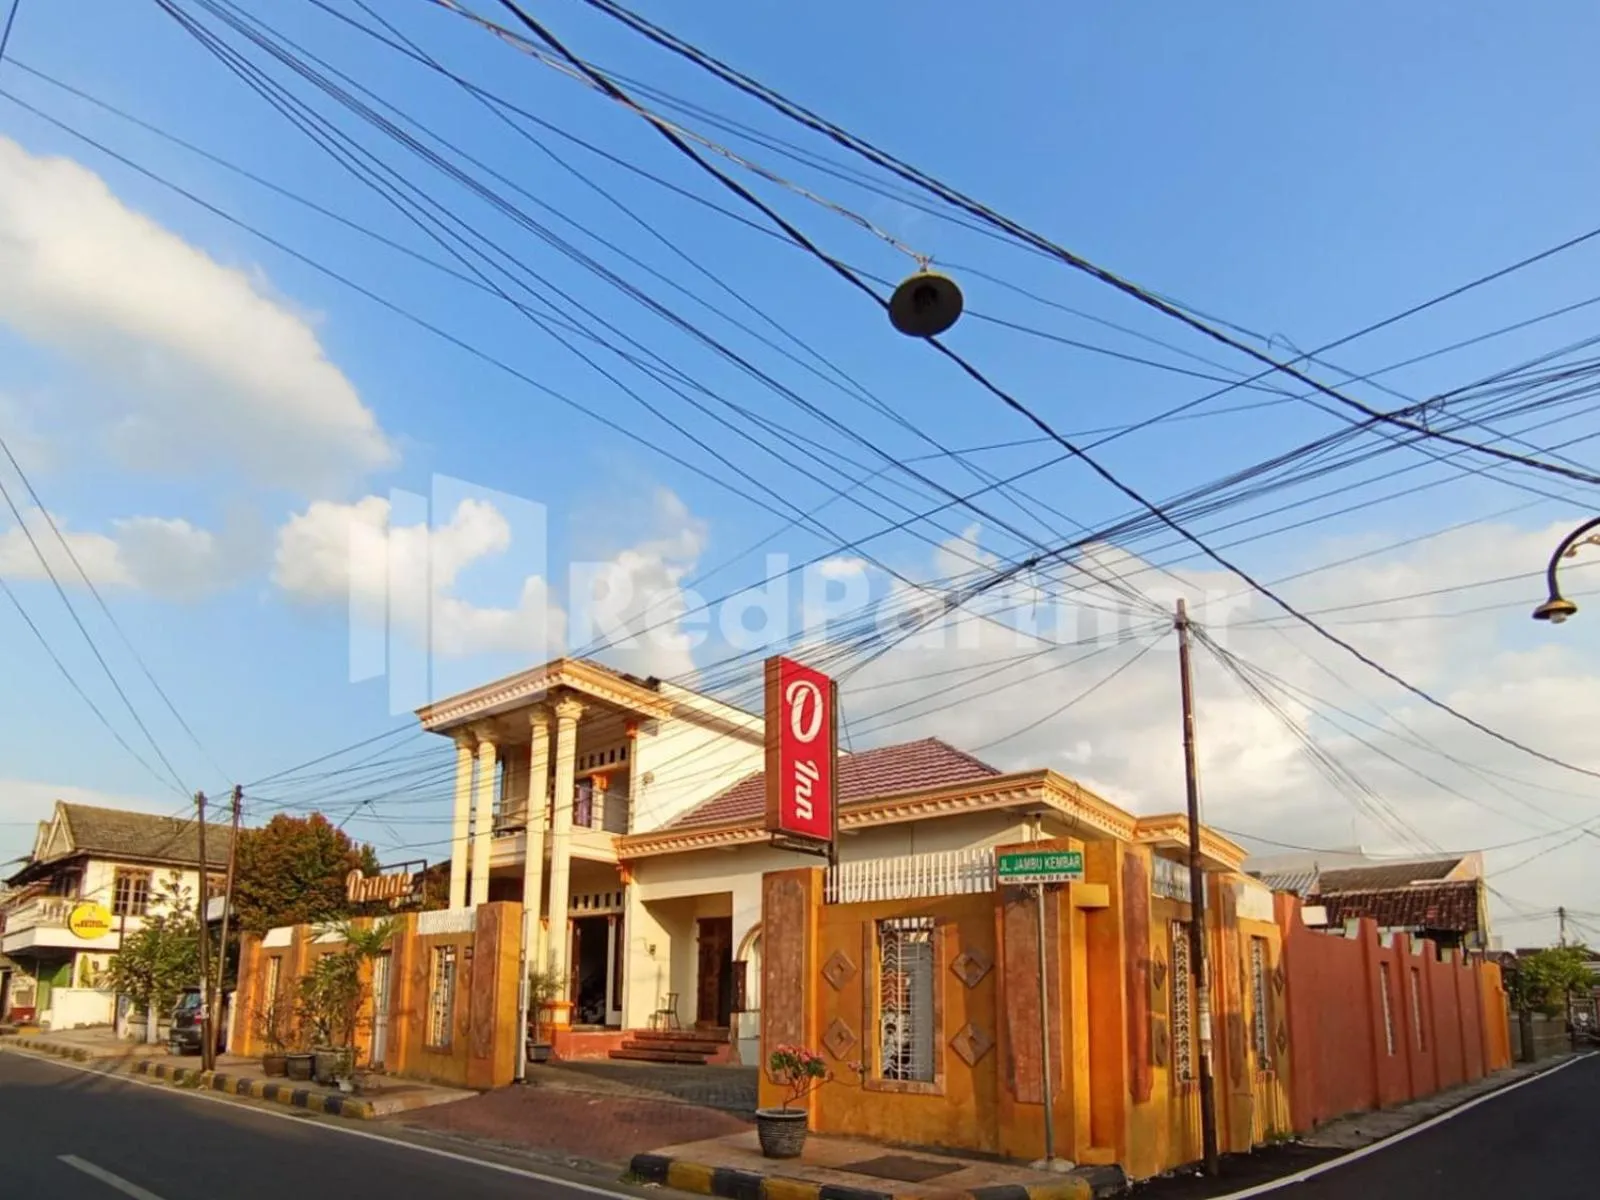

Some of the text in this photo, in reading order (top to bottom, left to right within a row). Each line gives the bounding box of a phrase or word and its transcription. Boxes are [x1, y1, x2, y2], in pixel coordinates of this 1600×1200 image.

[794, 760, 820, 820] Inn
[1013, 856, 1043, 872] JAMBU
[1044, 855, 1081, 870] KEMBAR
